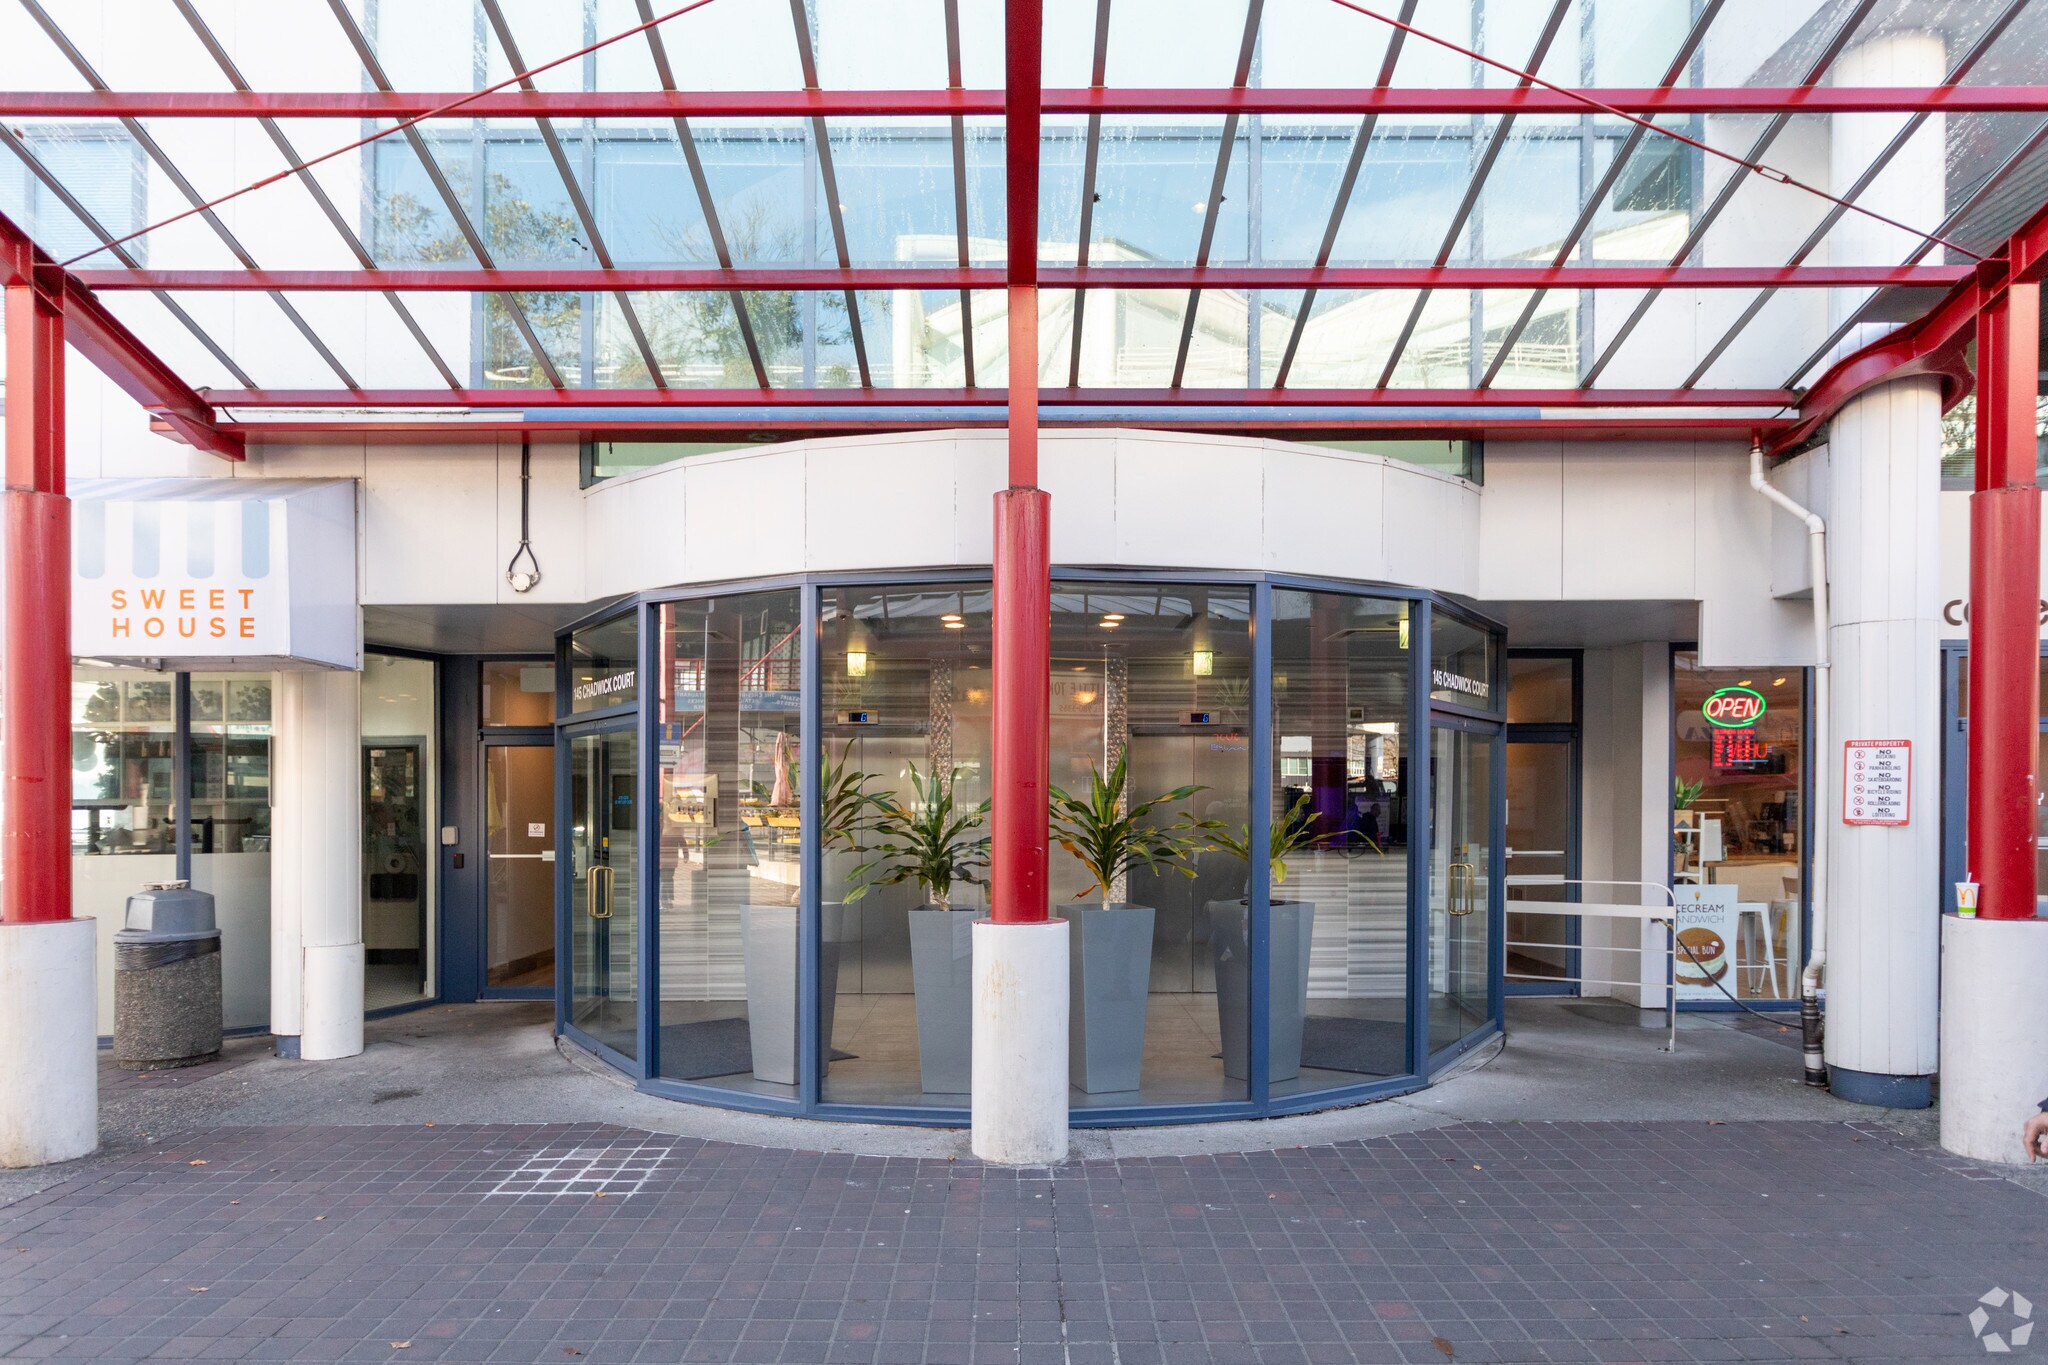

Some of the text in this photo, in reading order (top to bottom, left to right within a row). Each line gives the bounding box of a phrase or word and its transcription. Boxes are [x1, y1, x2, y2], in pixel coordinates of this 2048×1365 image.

[111, 589, 254, 610] SWEET
[112, 617, 255, 638] HOUSE
[573, 671, 635, 701] 145 CHADWICK COURT
[1433, 669, 1489, 698] 145 CHADWICK COURT
[1706, 698, 1760, 718] OPEN
[1676, 904, 1725, 913] CECREAM
[1676, 915, 1725, 924] ANDWICH
[1701, 945, 1716, 955] BUN
